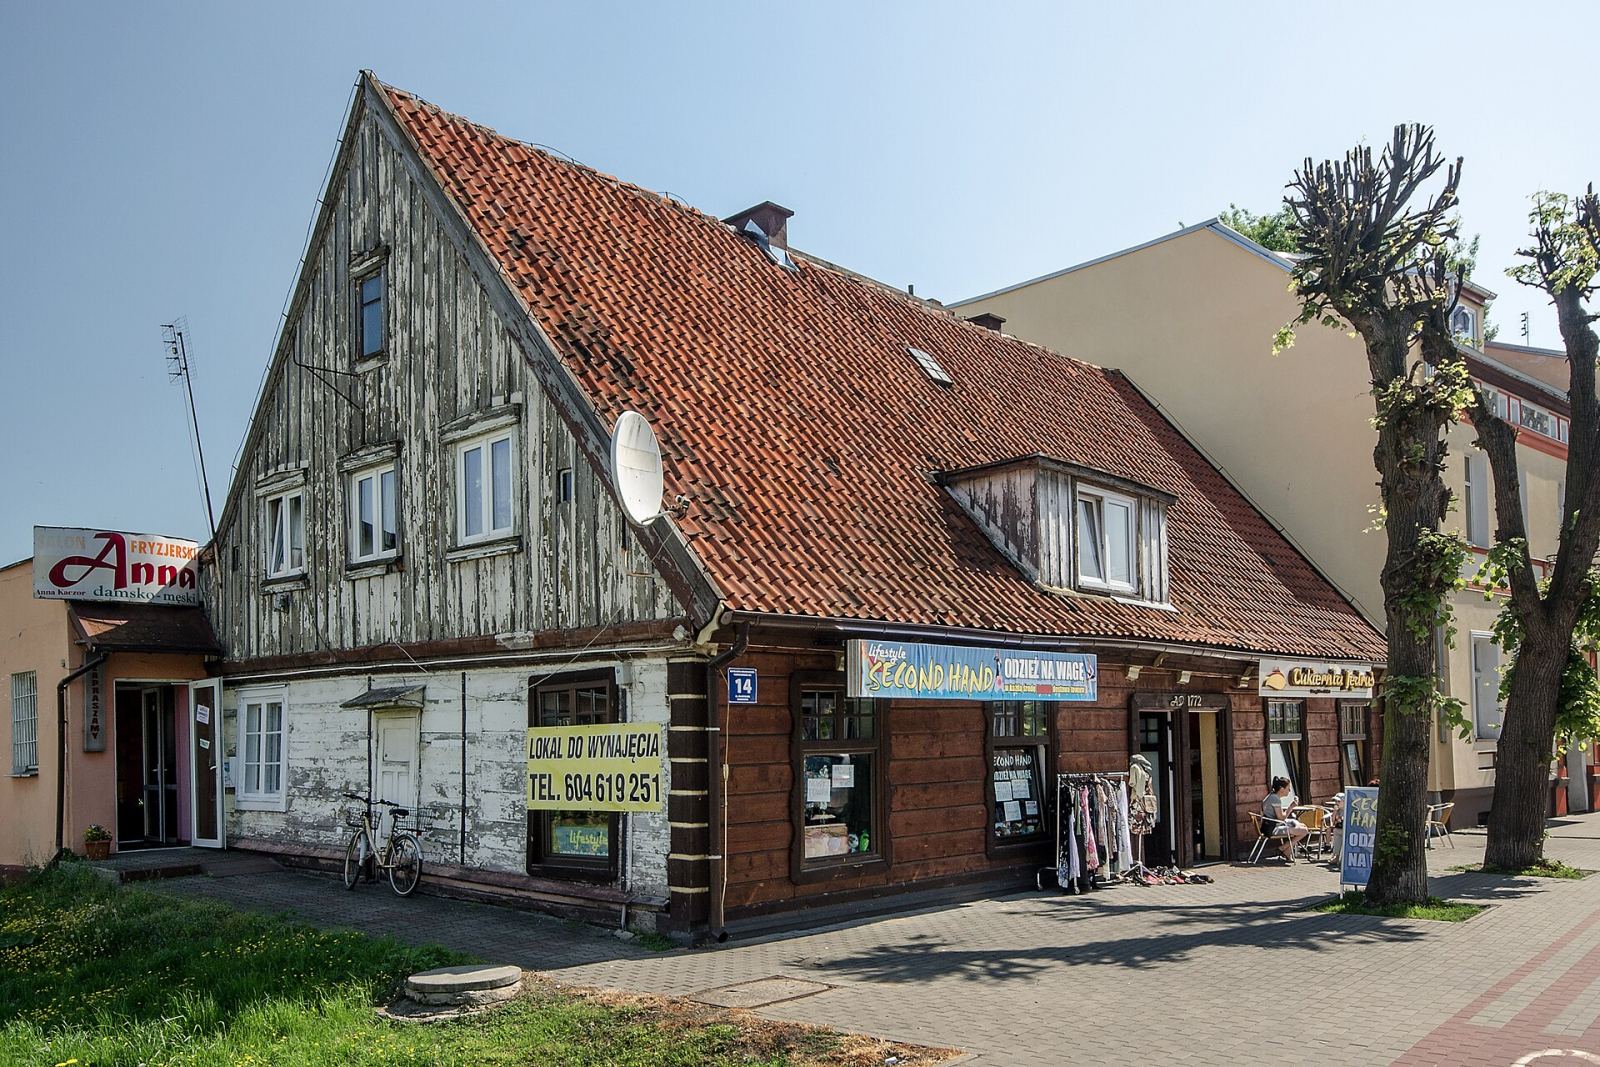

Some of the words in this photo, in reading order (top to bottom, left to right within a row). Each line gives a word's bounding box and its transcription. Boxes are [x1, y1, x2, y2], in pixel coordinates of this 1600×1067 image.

[130, 541, 197, 560] FRYZJERSKI
[48, 532, 196, 590] Anna
[868, 644, 906, 663] lifestyle
[868, 657, 944, 691] SECOND
[949, 661, 993, 694] HAND
[1004, 656, 1040, 679] ODZIEŻ
[1040, 660, 1055, 680] NA
[1056, 661, 1085, 683] WAGĘ
[735, 678, 752, 694] 14
[1187, 694, 1202, 707] 1772
[529, 737, 562, 759] LOKAL
[567, 736, 583, 759] DO
[588, 733, 659, 763] WYNAJĘCIA
[1014, 754, 1032, 767] HAND
[530, 773, 560, 801] TEL.
[565, 773, 592, 801] 604
[596, 773, 625, 802] 619
[629, 773, 660, 802] 251
[569, 829, 608, 852] lifestyle
[1349, 832, 1375, 848] ODZ
[1348, 852, 1366, 867] NA
